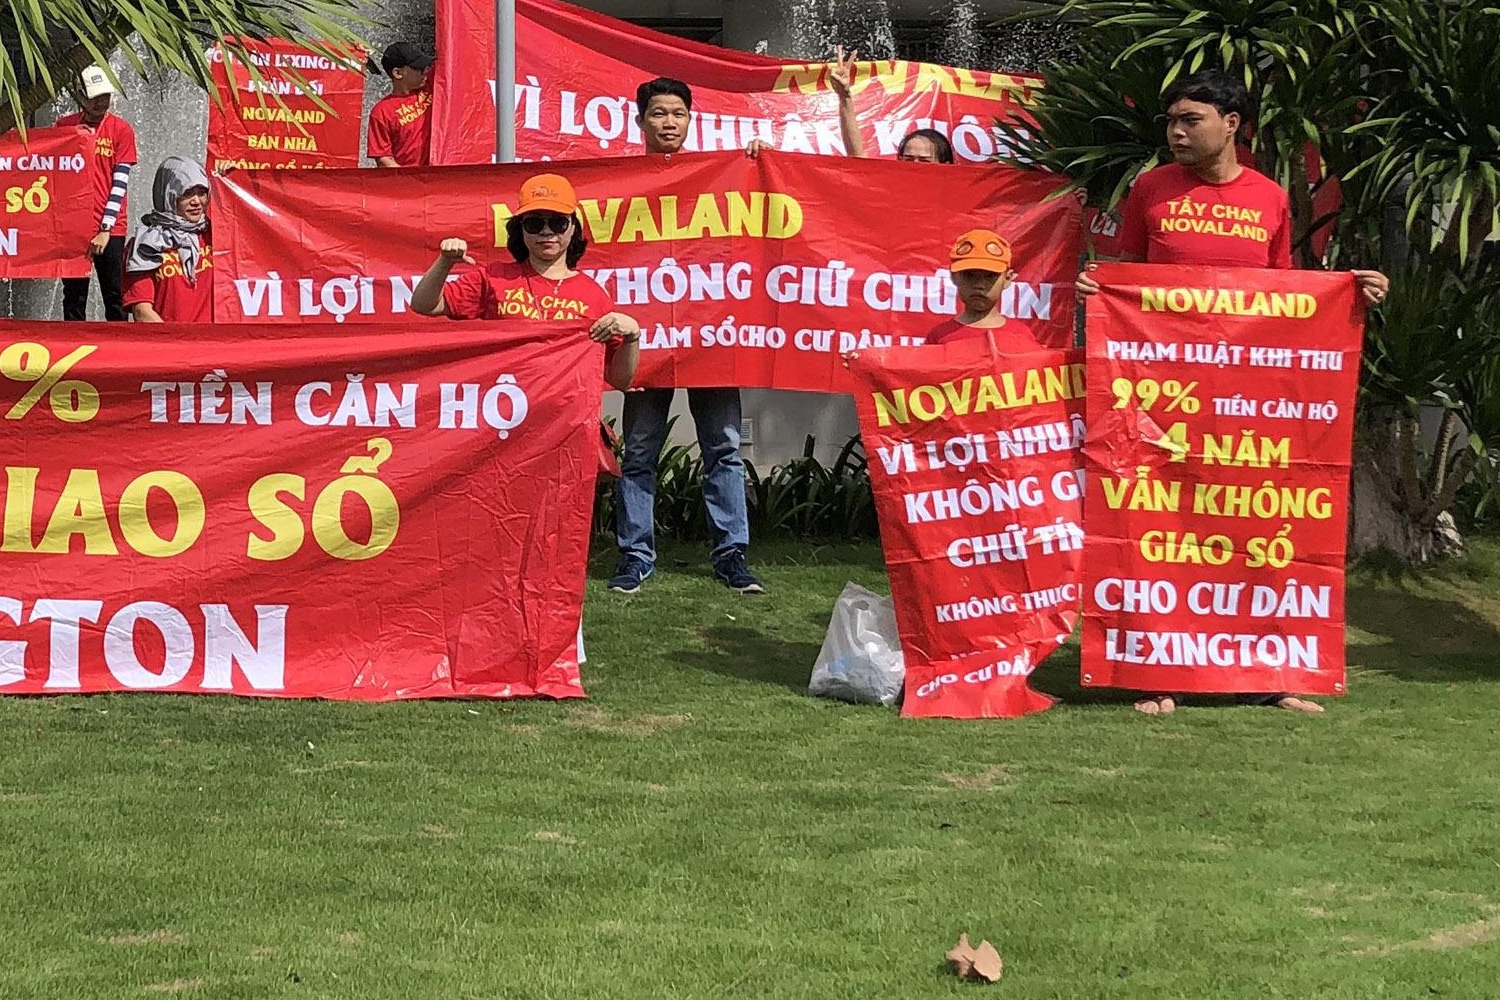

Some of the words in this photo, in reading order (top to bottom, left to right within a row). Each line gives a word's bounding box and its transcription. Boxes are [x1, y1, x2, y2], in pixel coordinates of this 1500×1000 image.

[247, 132, 280, 150] BÁN
[17, 153, 55, 171] CĂN
[59, 153, 86, 174] HỘ
[5, 175, 50, 213] SỔ
[1211, 203, 1263, 224] CHAY
[491, 191, 804, 249] NVALAND
[1160, 217, 1268, 243] NOVALAND
[234, 270, 284, 317] VÌ
[299, 274, 375, 324] LỢI
[765, 259, 854, 309] GIỮ
[540, 295, 590, 316] CHAY
[1140, 286, 1318, 320] NOVALAND
[638, 322, 693, 350] LÀM
[700, 315, 738, 348] SỔ
[738, 324, 787, 349] CHO
[793, 328, 836, 353] CƯ
[1106, 339, 1178, 367] PHẠM
[1184, 340, 1245, 370] LUẬT
[1249, 346, 1293, 370] KHI
[1298, 349, 1344, 372] THU
[140, 368, 273, 426] TIỀN
[295, 372, 417, 429] CĂN
[438, 374, 530, 440] HỘ
[1111, 377, 1201, 415] 99%
[1262, 397, 1304, 420] CĂN
[1307, 400, 1339, 425] HỘ
[875, 438, 918, 476] VÌ
[924, 433, 989, 473] LỢI
[1158, 422, 1191, 464] 4
[1203, 429, 1291, 469] NĂM
[246, 437, 401, 561] SỔ
[903, 478, 1044, 525] KHÔNG
[1050, 467, 1086, 502] GI
[1100, 465, 1182, 512] VẪN
[1192, 480, 1333, 520] KHÔNG
[947, 523, 1029, 568] CHỮ
[1139, 529, 1234, 566] GIAO
[1245, 523, 1295, 569] SỔ
[935, 595, 1019, 623] KHÔNG
[1094, 577, 1178, 615] CHO
[1187, 582, 1246, 617] CƯ
[1250, 578, 1332, 618] DÂN
[1105, 628, 1319, 669] LEXINGTON
[916, 673, 959, 697] CHO
[963, 663, 995, 684] CƯ
